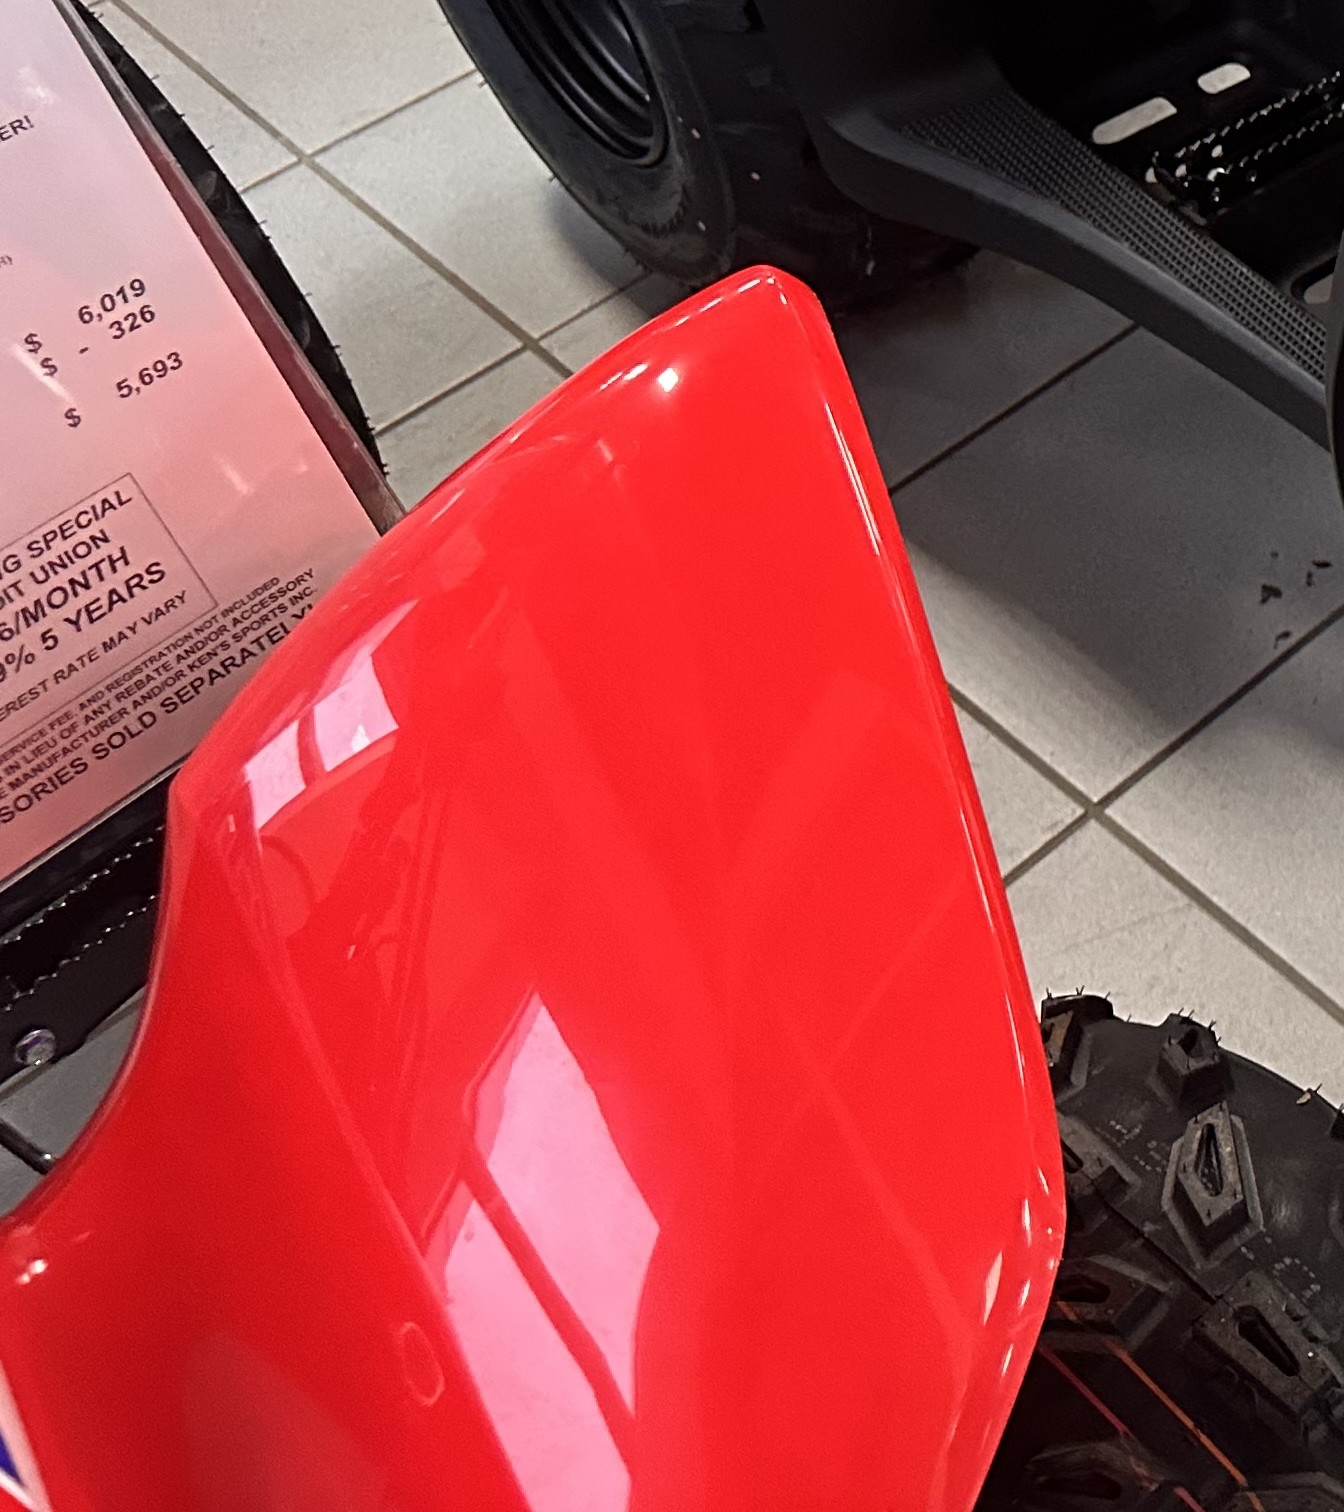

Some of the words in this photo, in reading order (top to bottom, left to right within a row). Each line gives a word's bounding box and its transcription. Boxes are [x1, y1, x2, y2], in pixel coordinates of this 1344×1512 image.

[24, 332, 42, 354] $
[78, 278, 146, 325] 6,019
[40, 357, 58, 377] $
[109, 304, 156, 340] 326
[64, 407, 82, 428] $
[116, 351, 183, 399] 5,693
[26, 490, 133, 559] SPECIAL
[29, 528, 111, 585] UNION
[40, 628, 58, 651] 5
[63, 561, 166, 632] YEARS
[53, 648, 100, 685] RATE
[101, 621, 138, 654] MAY
[140, 590, 187, 626] VARY
[0, 727, 49, 763] ERVICE
[78, 690, 105, 712] AND
[105, 632, 194, 693] REGISTRATION
[193, 614, 220, 635] NOT
[220, 577, 281, 619] INCLUDED
[4, 760, 22, 776] IN
[22, 737, 58, 764] LIEU
[59, 721, 79, 739] OF
[83, 699, 112, 726] ANY
[114, 661, 174, 703] REBATE
[175, 624, 231, 664] AND/OR
[231, 568, 314, 628] ACCESSORY
[8, 707, 131, 791] MANUFACTURER
[131, 669, 188, 710] AND/OR
[187, 640, 231, 673] KEN'S
[231, 603, 288, 643] SPORTS
[0, 757, 88, 823] SORIES
[91, 711, 157, 760] SOLD
